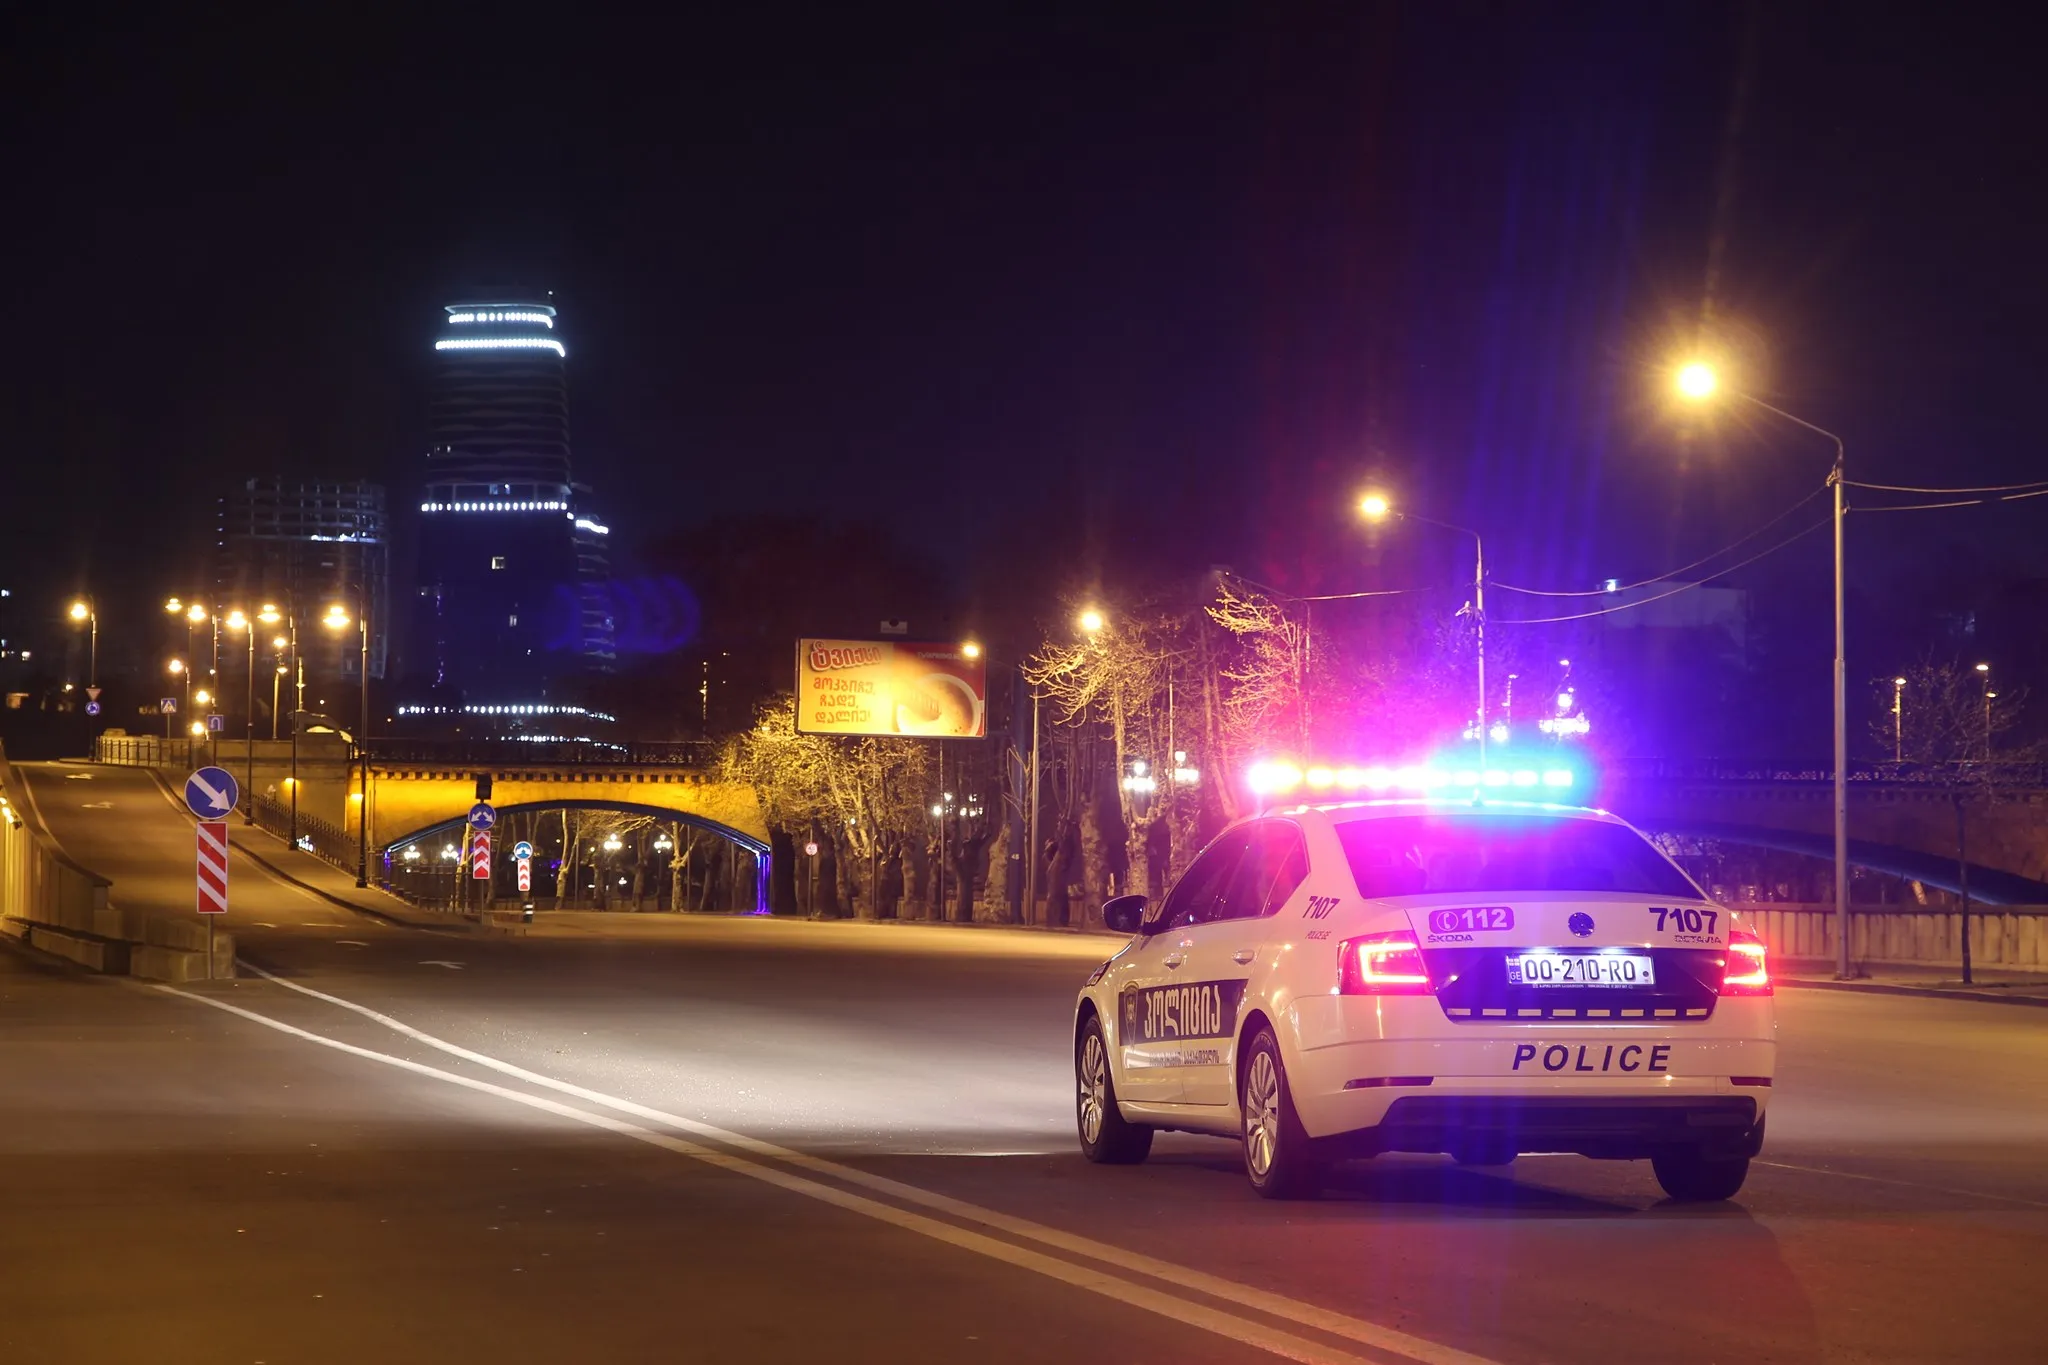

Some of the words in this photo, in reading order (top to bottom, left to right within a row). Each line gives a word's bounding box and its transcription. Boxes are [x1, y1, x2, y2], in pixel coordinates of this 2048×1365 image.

[1302, 896, 1340, 919] 7107
[1461, 908, 1508, 930] 112
[1649, 907, 1718, 934] 7107
[1509, 971, 1521, 981] GE
[1144, 985, 1221, 1039] პოლიცია
[1512, 1045, 1671, 1072] POLICE
